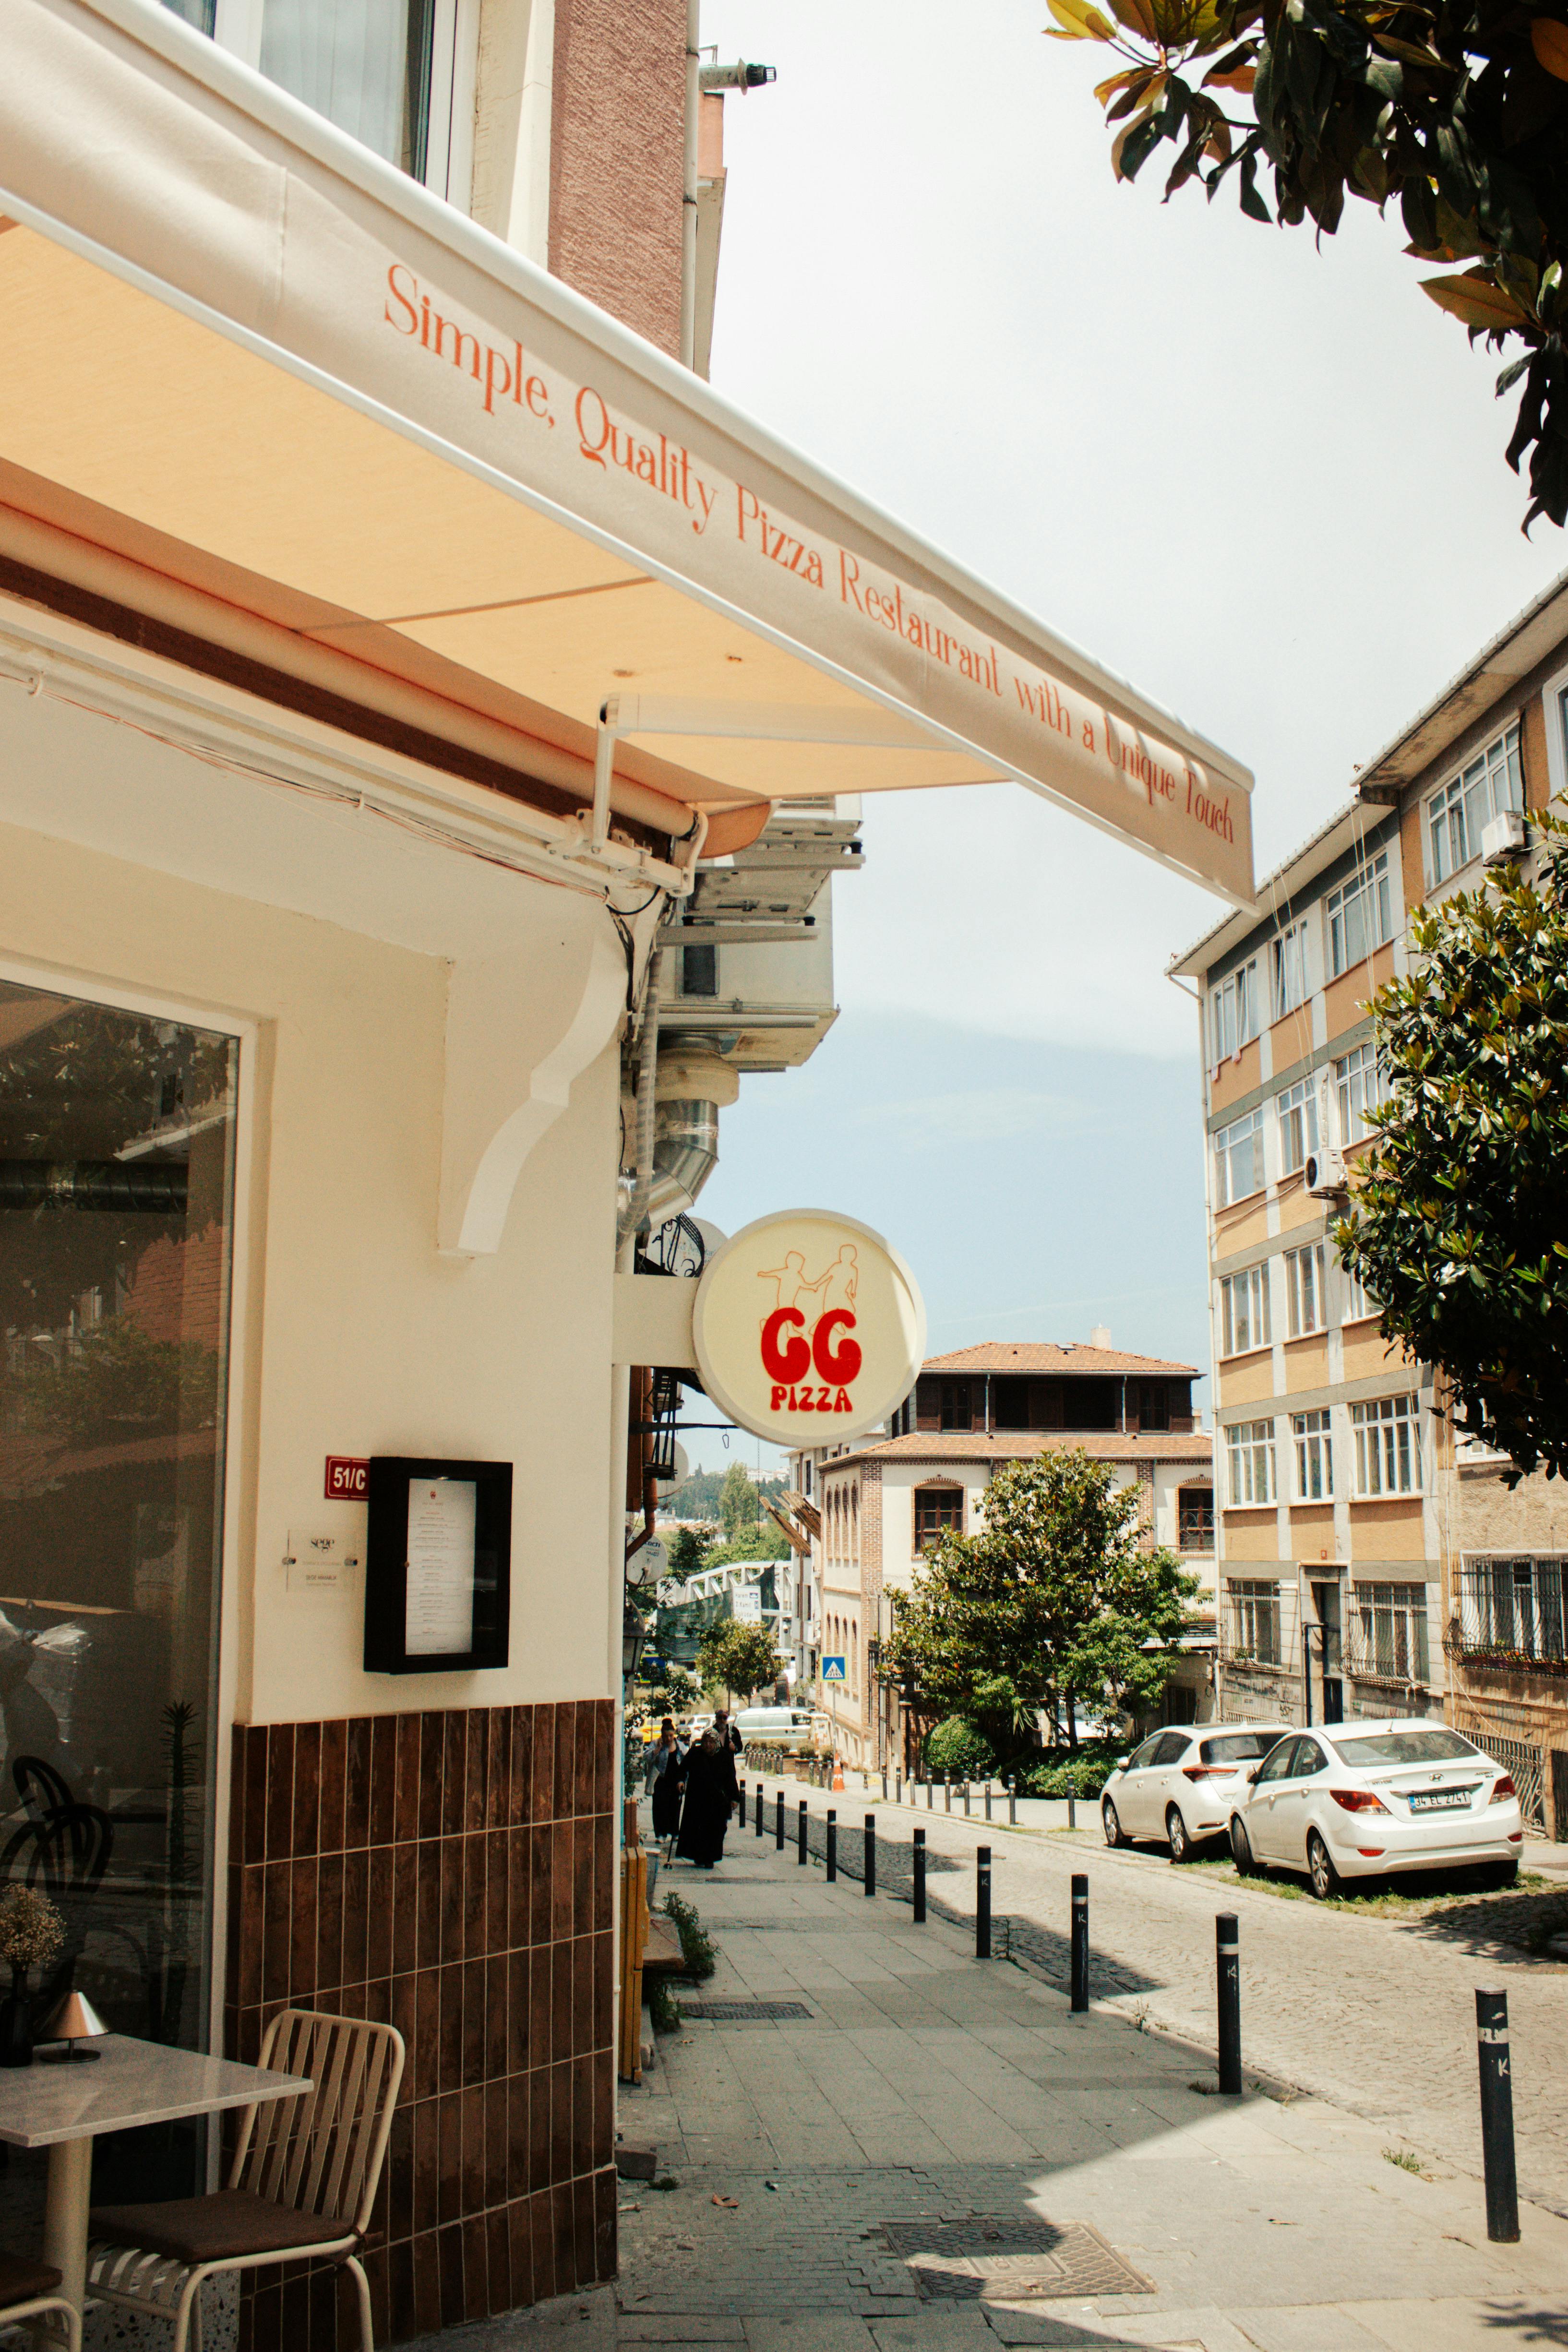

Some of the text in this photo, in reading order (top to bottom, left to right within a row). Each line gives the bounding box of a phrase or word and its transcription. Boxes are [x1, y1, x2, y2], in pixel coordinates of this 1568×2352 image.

[384, 263, 1235, 845] Simple, Quality Pizza Restaurant with a Unique Touch
[770, 1385, 853, 1413] PIZZA
[333, 1467, 366, 1490] 51/C
[1414, 1795, 1426, 1806] 34
[1429, 1794, 1441, 1804] EL
[1498, 2058, 1510, 2077] K
